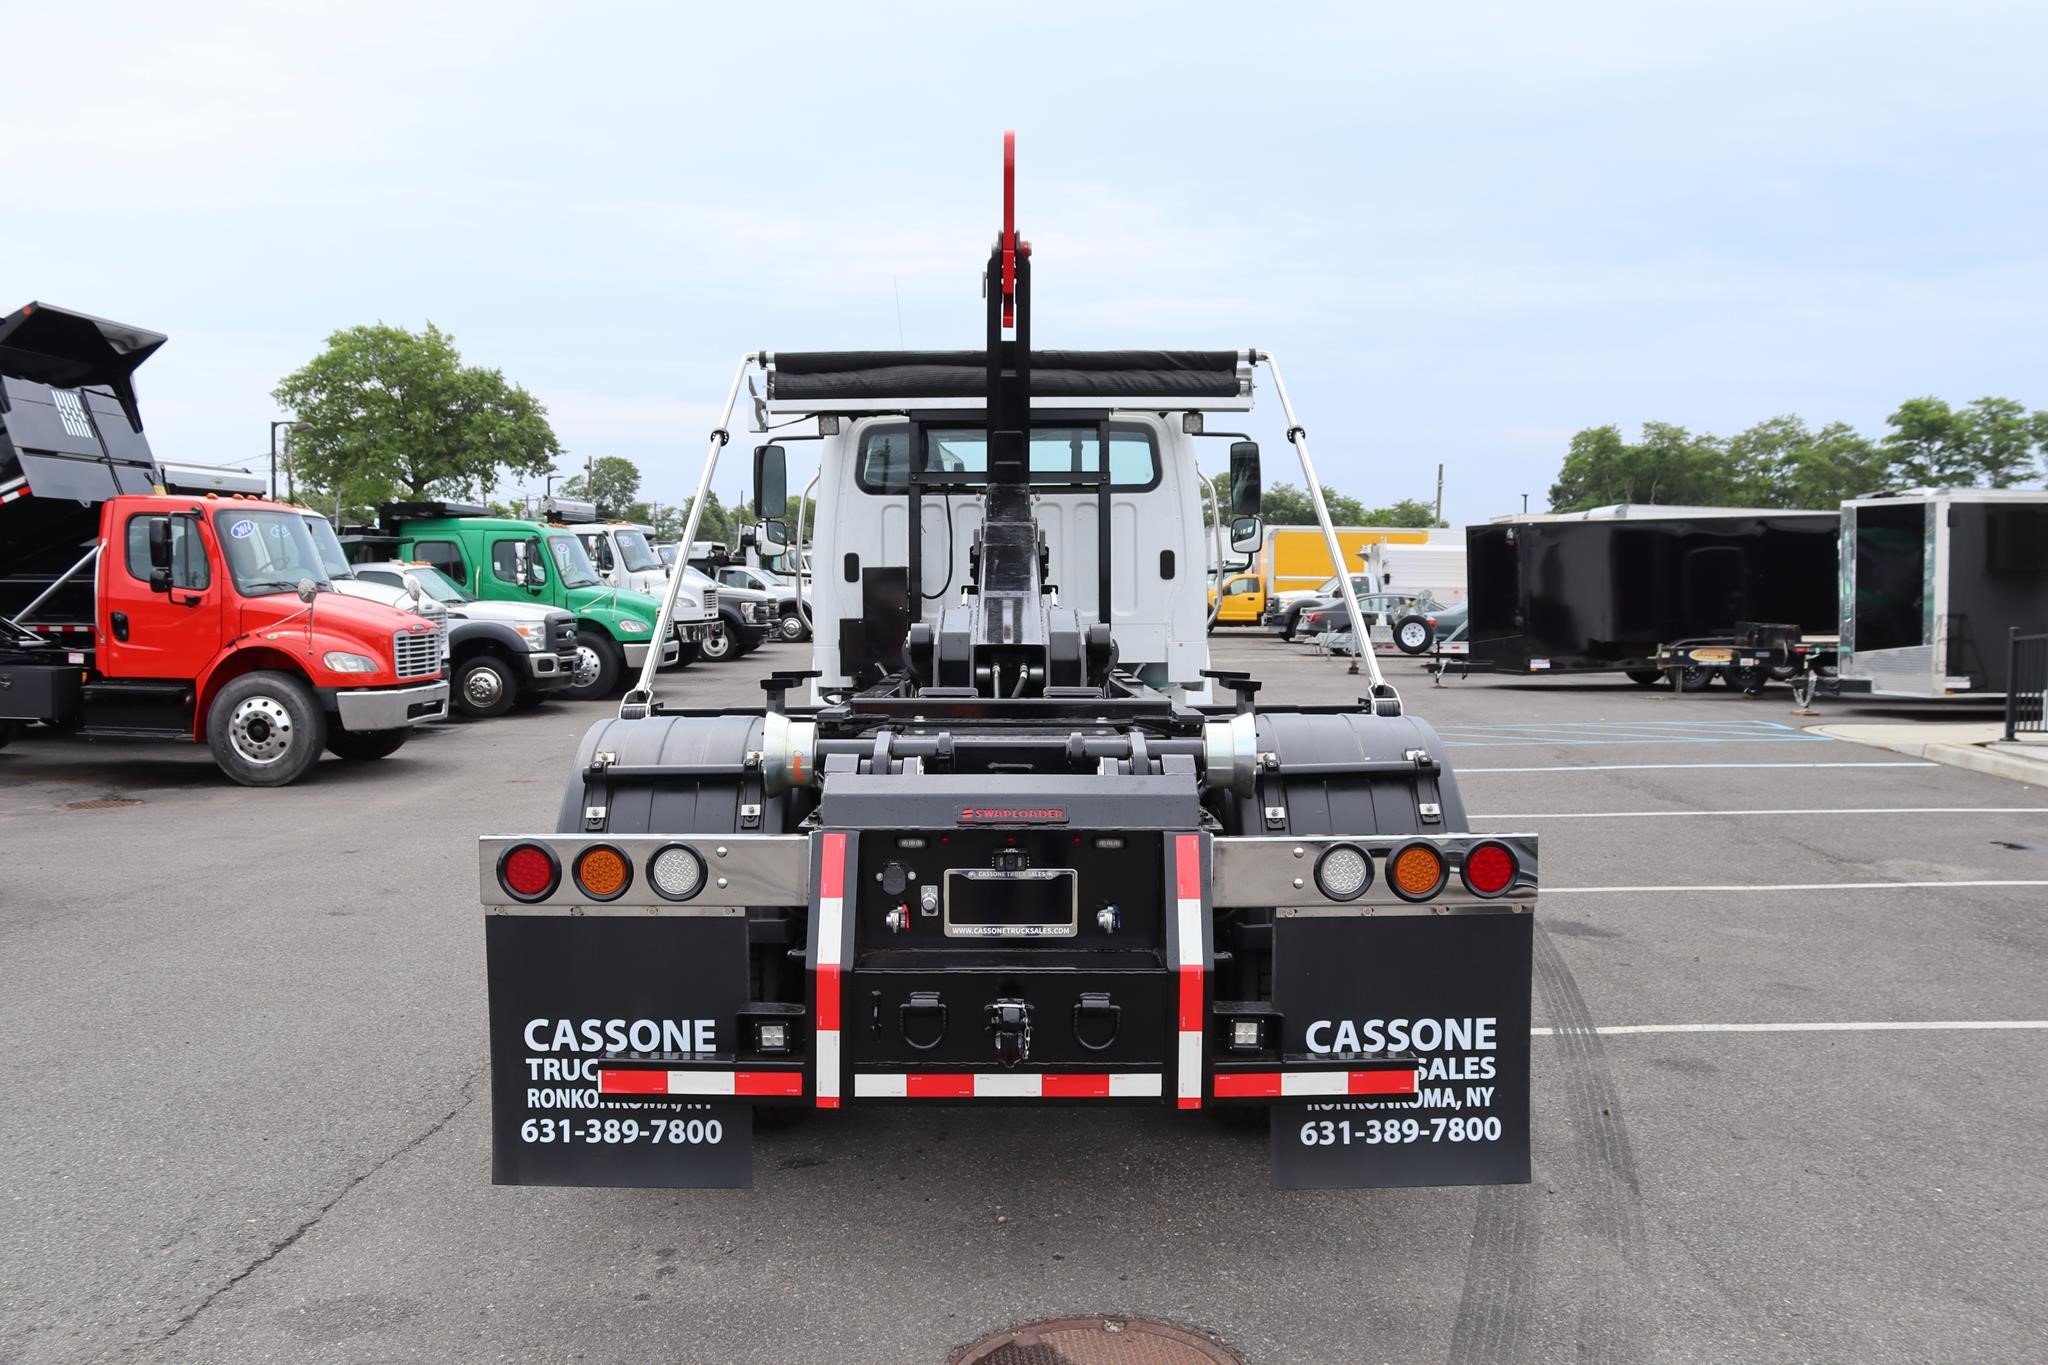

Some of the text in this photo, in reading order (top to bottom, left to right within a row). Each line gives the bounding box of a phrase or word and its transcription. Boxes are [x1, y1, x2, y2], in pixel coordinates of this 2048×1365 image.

[976, 809, 1063, 818] SWAPLOADER
[524, 1018, 716, 1052] CASSONE
[1305, 1017, 1497, 1053] CASSONE
[525, 1058, 599, 1081] TRUC
[1418, 1056, 1496, 1080] SALES
[1466, 1087, 1495, 1107] NY
[521, 1118, 722, 1144] 631-389-7800
[1300, 1116, 1502, 1146] 631-389-7800
